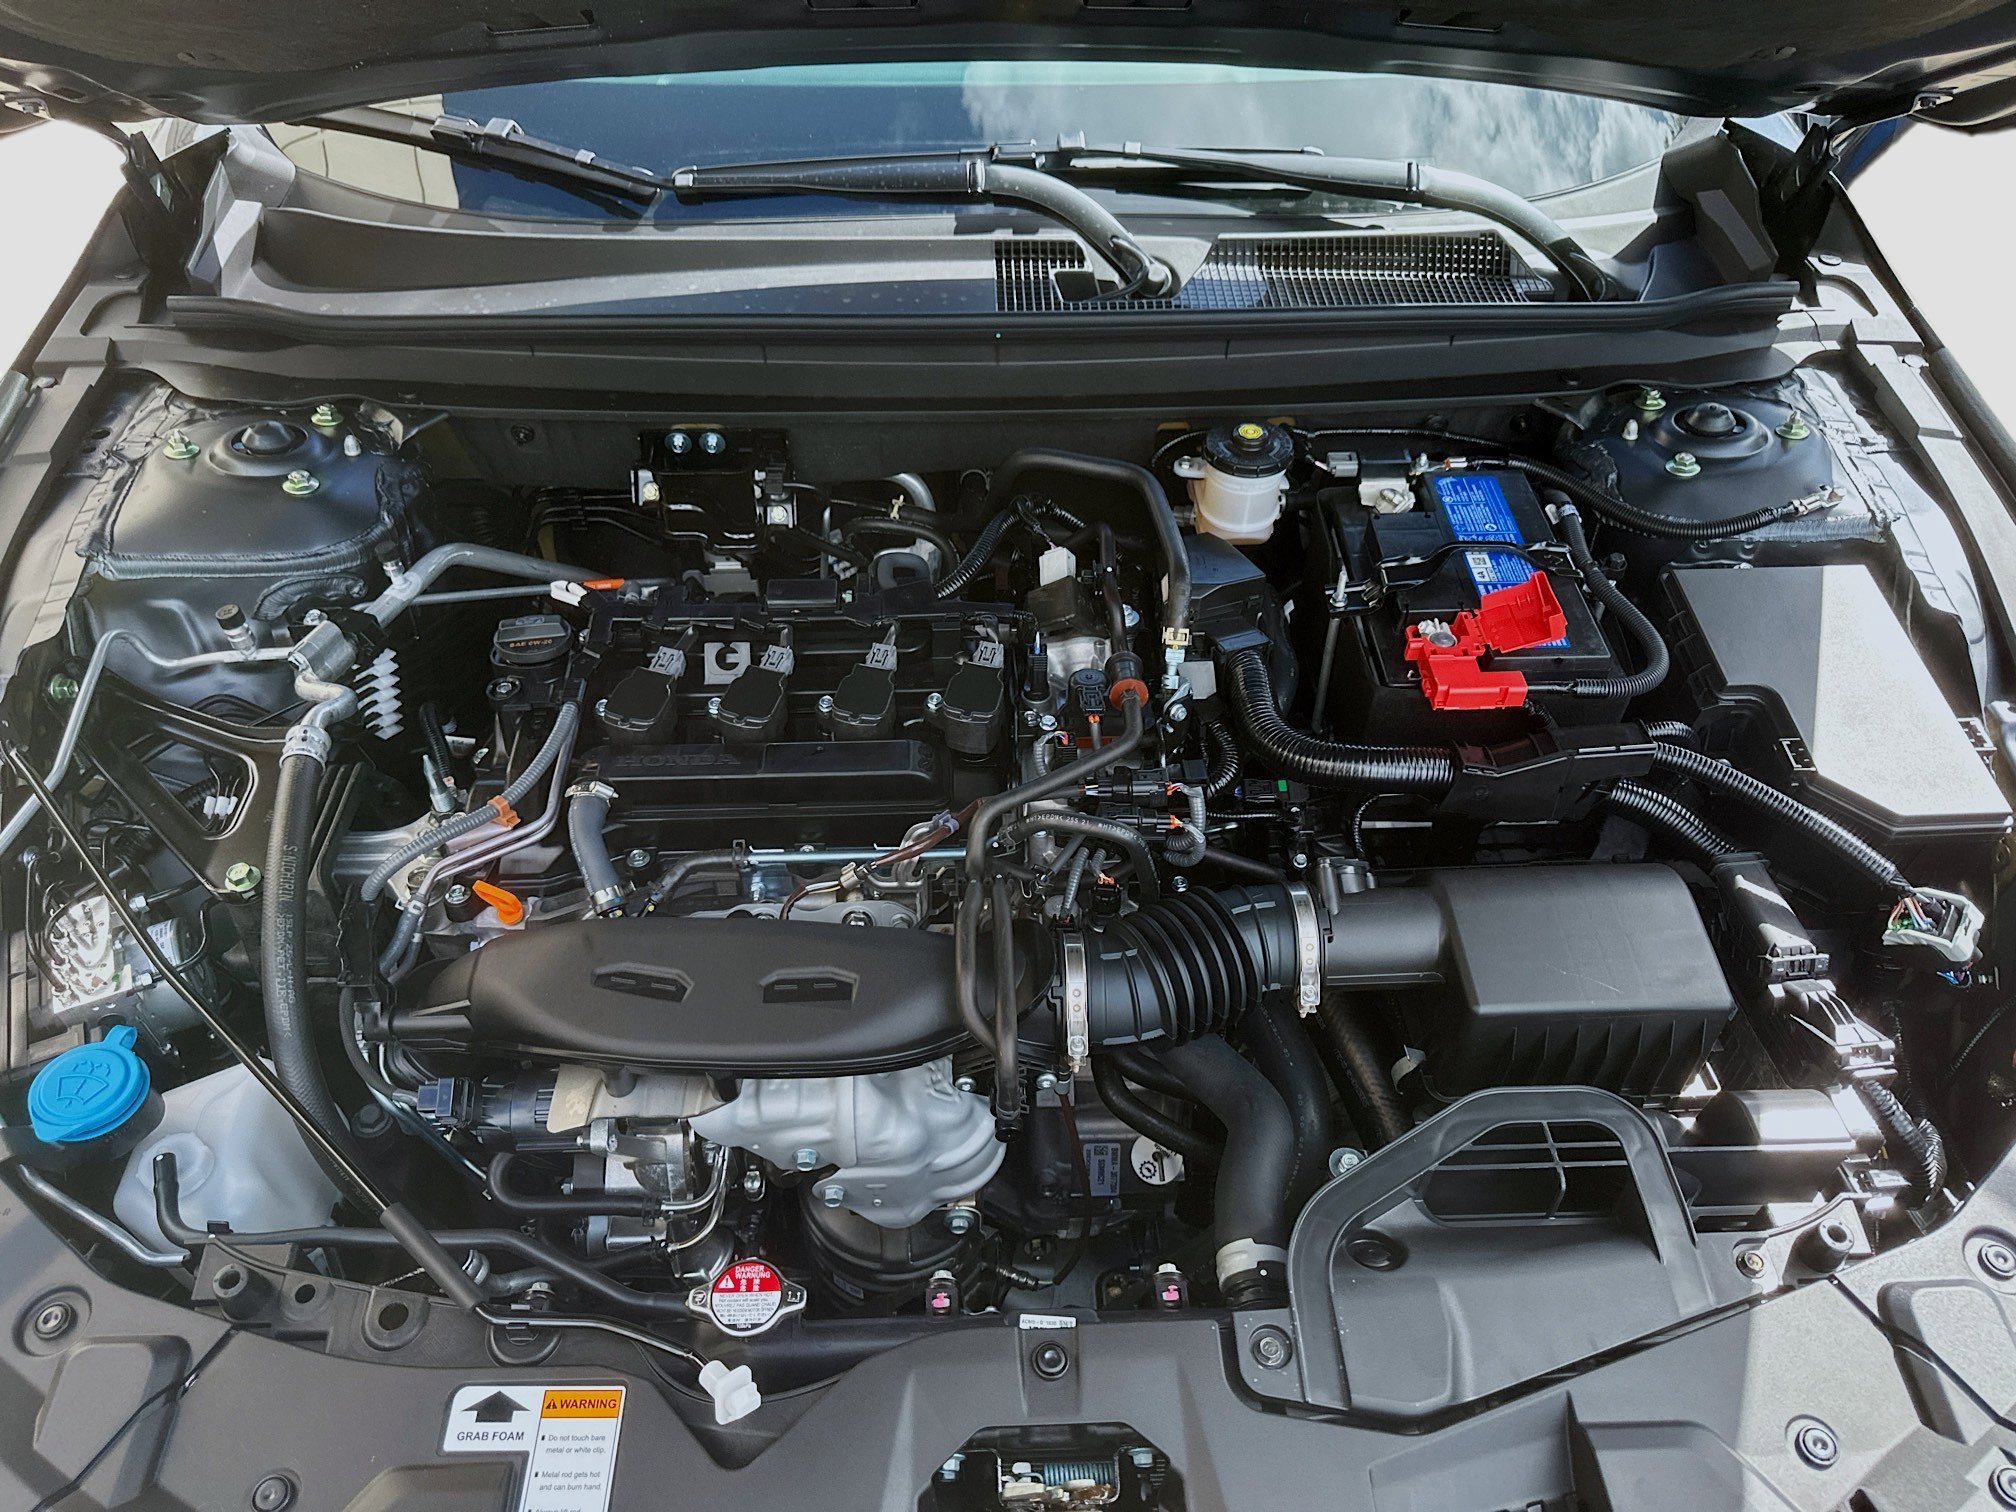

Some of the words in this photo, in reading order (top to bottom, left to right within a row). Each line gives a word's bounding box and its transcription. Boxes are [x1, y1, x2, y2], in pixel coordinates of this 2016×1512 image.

[615, 753, 741, 768] HONDA
[735, 1265, 765, 1273] DANGER
[735, 1271, 771, 1280] WARNUNG
[559, 1399, 617, 1409] WARNING
[456, 1431, 489, 1441] GRAB
[491, 1431, 525, 1441] FOAM
[573, 1471, 588, 1480] gets
